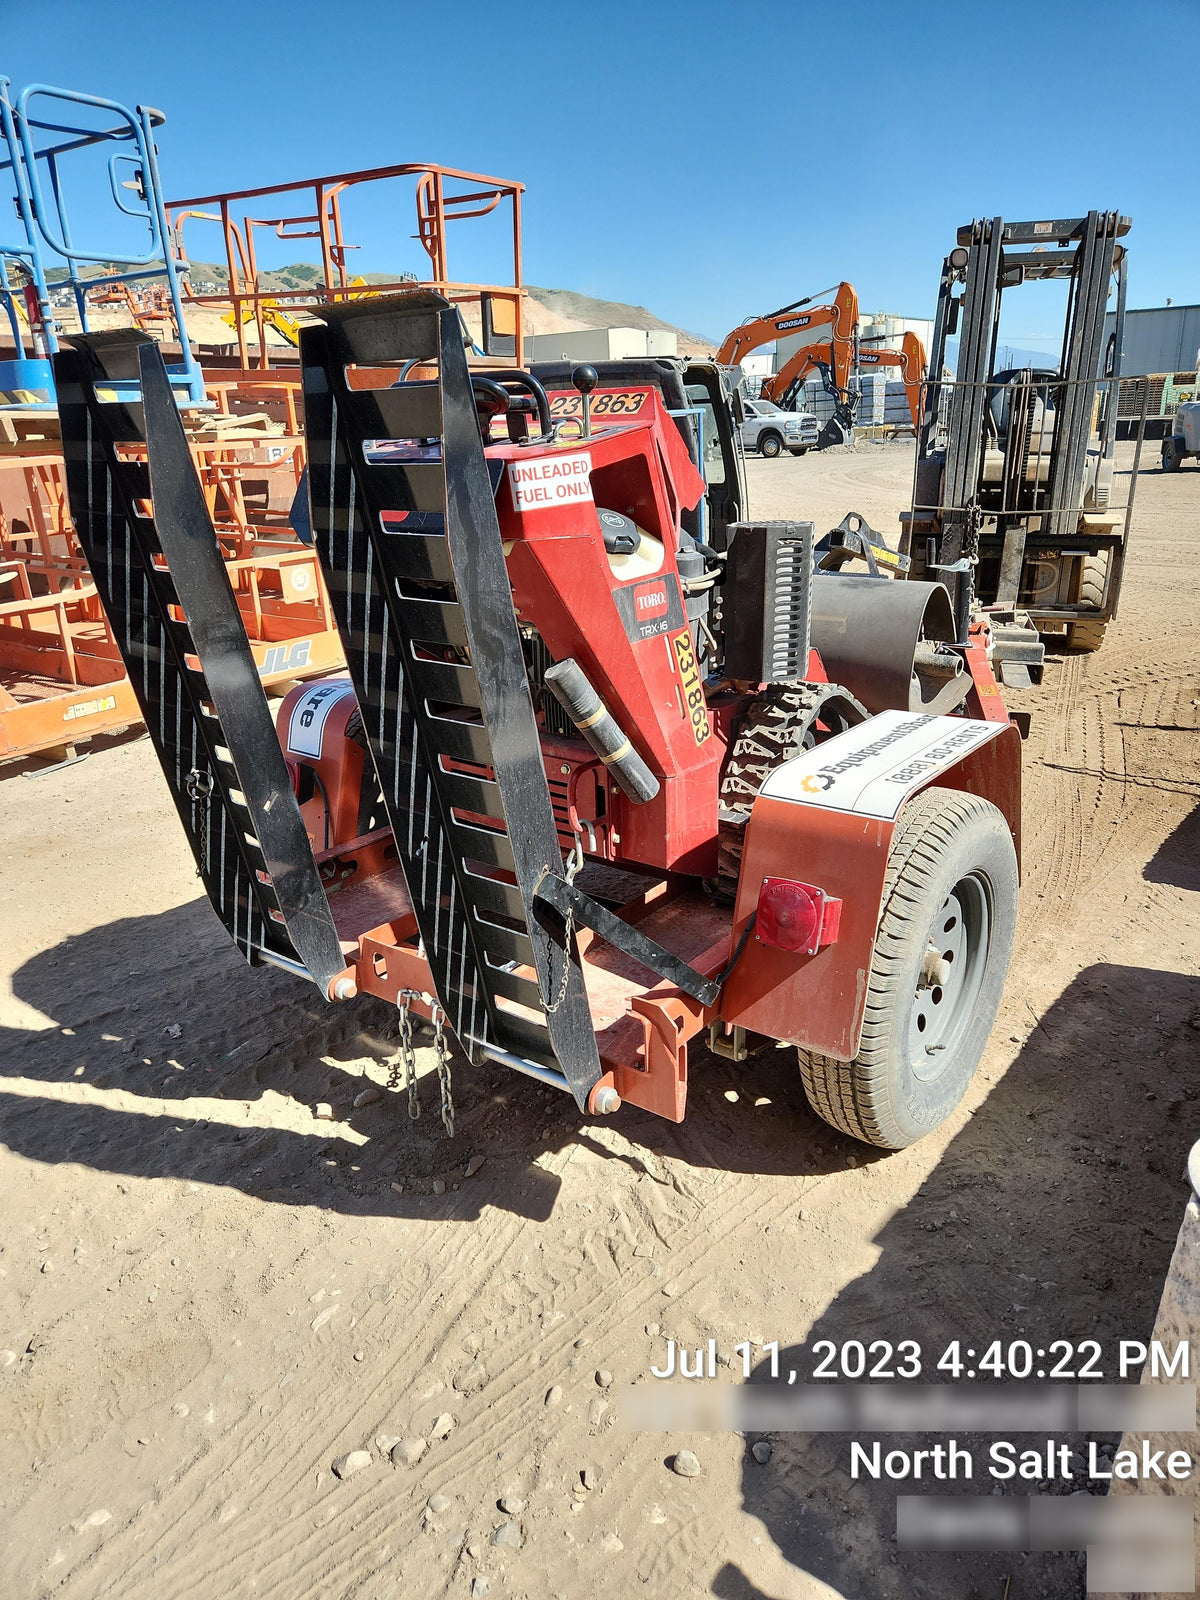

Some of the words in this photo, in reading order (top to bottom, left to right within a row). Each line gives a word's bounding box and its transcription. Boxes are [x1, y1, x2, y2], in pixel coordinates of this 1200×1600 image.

[778, 317, 809, 329] DOOSAN
[511, 460, 589, 484] UNLEADED
[515, 487, 553, 505] FUEL
[556, 481, 591, 498] ONLY
[637, 591, 665, 610] TORO
[257, 640, 312, 676] JLG
[675, 634, 710, 743] 231863
[884, 759, 937, 784] (888)
[924, 725, 990, 760] 80-RENTS
